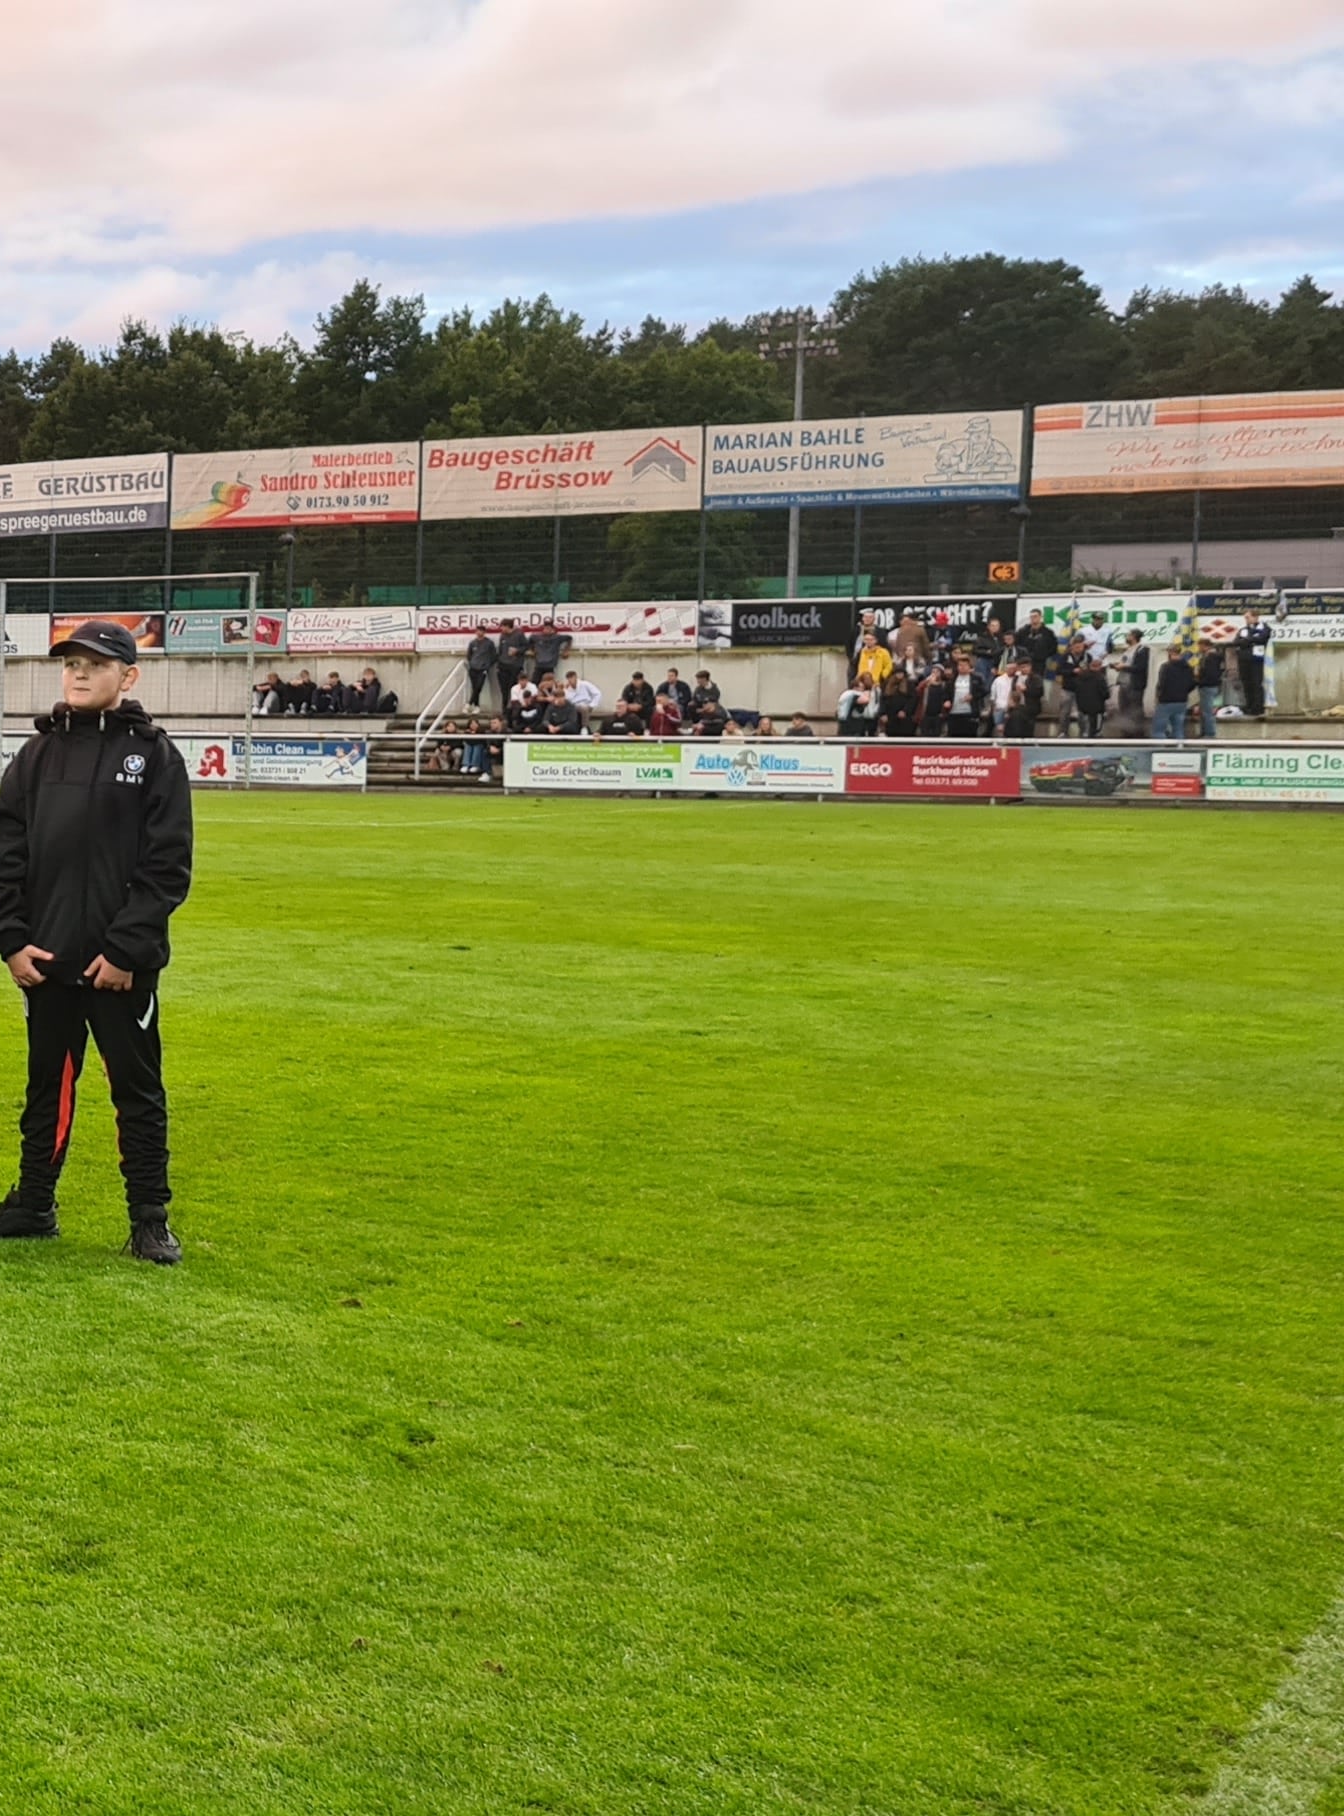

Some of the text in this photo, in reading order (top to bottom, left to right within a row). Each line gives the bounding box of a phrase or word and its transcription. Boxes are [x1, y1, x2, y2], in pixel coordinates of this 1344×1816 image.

[1085, 403, 1153, 429] ZHW
[713, 427, 865, 451] MARIAN BAHLE
[311, 451, 393, 468] Malerbetrieb
[427, 440, 595, 471] Baugeschäft
[712, 451, 885, 475] BAUAUSFÜHRUNG
[38, 471, 165, 497] GERÜSTBAU
[260, 470, 416, 492] Sandro Schleusner
[495, 468, 614, 491] Brüssow
[370, 493, 390, 506] 912
[992, 564, 1016, 581] C3
[426, 612, 596, 630] RS Fliesn-Design
[738, 606, 822, 630] coolback
[234, 742, 304, 755] Trbbin Clean
[696, 753, 731, 770] Auto
[759, 755, 800, 771] Klaus
[849, 762, 892, 777] ERGO
[912, 755, 998, 767] Bezirksdirektion
[1211, 753, 1344, 774] Fläming Cle
[532, 765, 661, 778] Carlo Eichelbaum LVM
[912, 766, 961, 777] Burkhard
